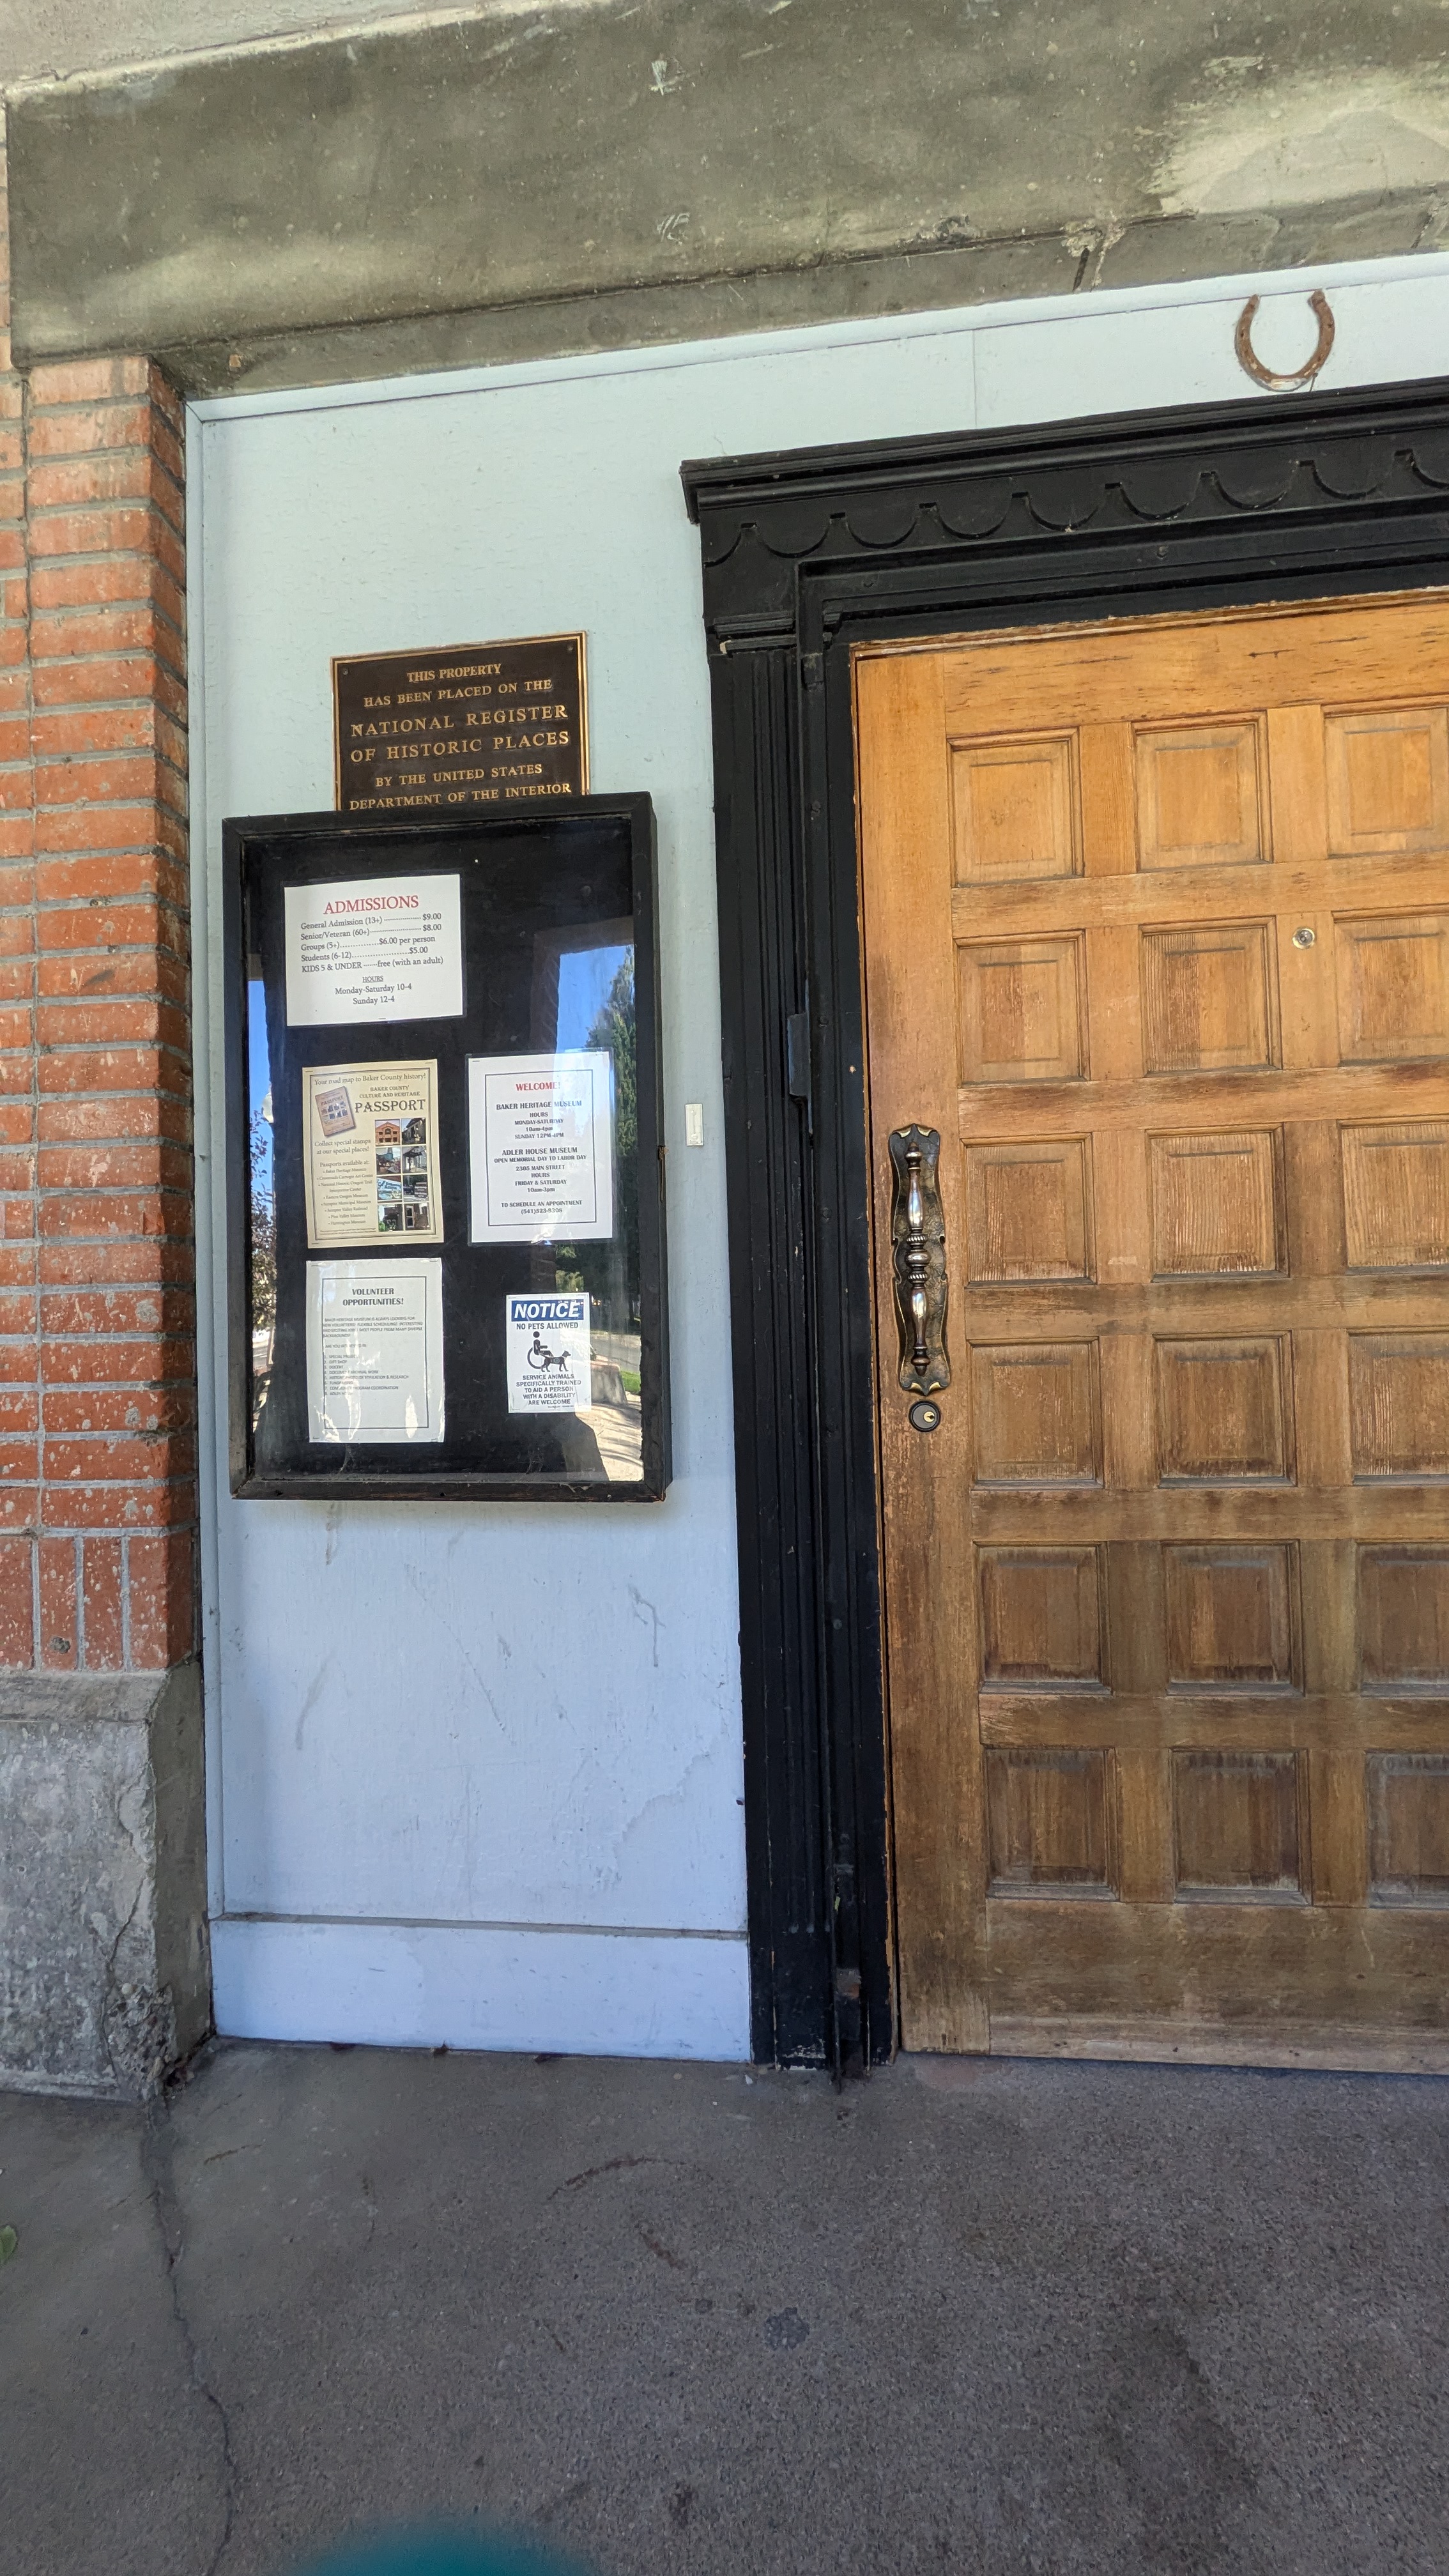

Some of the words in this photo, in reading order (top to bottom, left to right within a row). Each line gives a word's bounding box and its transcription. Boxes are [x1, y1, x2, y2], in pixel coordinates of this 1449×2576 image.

[407, 669, 435, 683] THIS
[439, 663, 502, 679] PROPERTY
[364, 695, 390, 707] HAS
[397, 691, 431, 703] BEEN
[438, 686, 492, 700] PLACED
[498, 683, 517, 694] ON
[525, 679, 552, 691] THE
[351, 716, 454, 737] NATIONAL
[466, 705, 568, 726] REGISTER
[351, 749, 376, 763] OF
[387, 739, 482, 760] HISTORIC
[493, 731, 570, 749] PLACES
[376, 776, 392, 787] BY
[399, 774, 426, 785] THE
[433, 769, 484, 782] UNITED
[491, 763, 542, 778] STATES
[349, 793, 441, 811] DEPARTMENT
[448, 792, 466, 802] OF
[471, 789, 498, 801] THE
[505, 783, 572, 797] INTERIOR
[323, 895, 419, 914] ADMISSIONS
[301, 921, 326, 930] General
[329, 919, 363, 927] Admission
[365, 916, 383, 925] (13+)
[301, 931, 351, 940] Senior/Veteran
[353, 928, 370, 937] (60+)
[301, 944, 325, 952] Groups
[326, 942, 339, 950] (5+)
[379, 937, 397, 946] $6.00
[399, 939, 411, 947] per
[413, 936, 435, 945] person
[301, 954, 330, 962] Students
[332, 951, 351, 960] (6-12)
[410, 946, 428, 955] $5.00
[302, 964, 319, 972] KIDS
[335, 962, 362, 970] UNDER
[378, 959, 390, 967] free
[392, 957, 411, 967] (with
[423, 956, 443, 965] adult)
[335, 985, 395, 995] Monday-Saturday
[353, 997, 378, 1005] Sunday
[516, 1082, 560, 1091] WELCOME!
[355, 1099, 425, 1113] PASSPORT
[352, 1287, 394, 1296] VOLUNTEER
[342, 1298, 404, 1307] OPPORTUNITIES!
[514, 1301, 580, 1319] NOTICE
